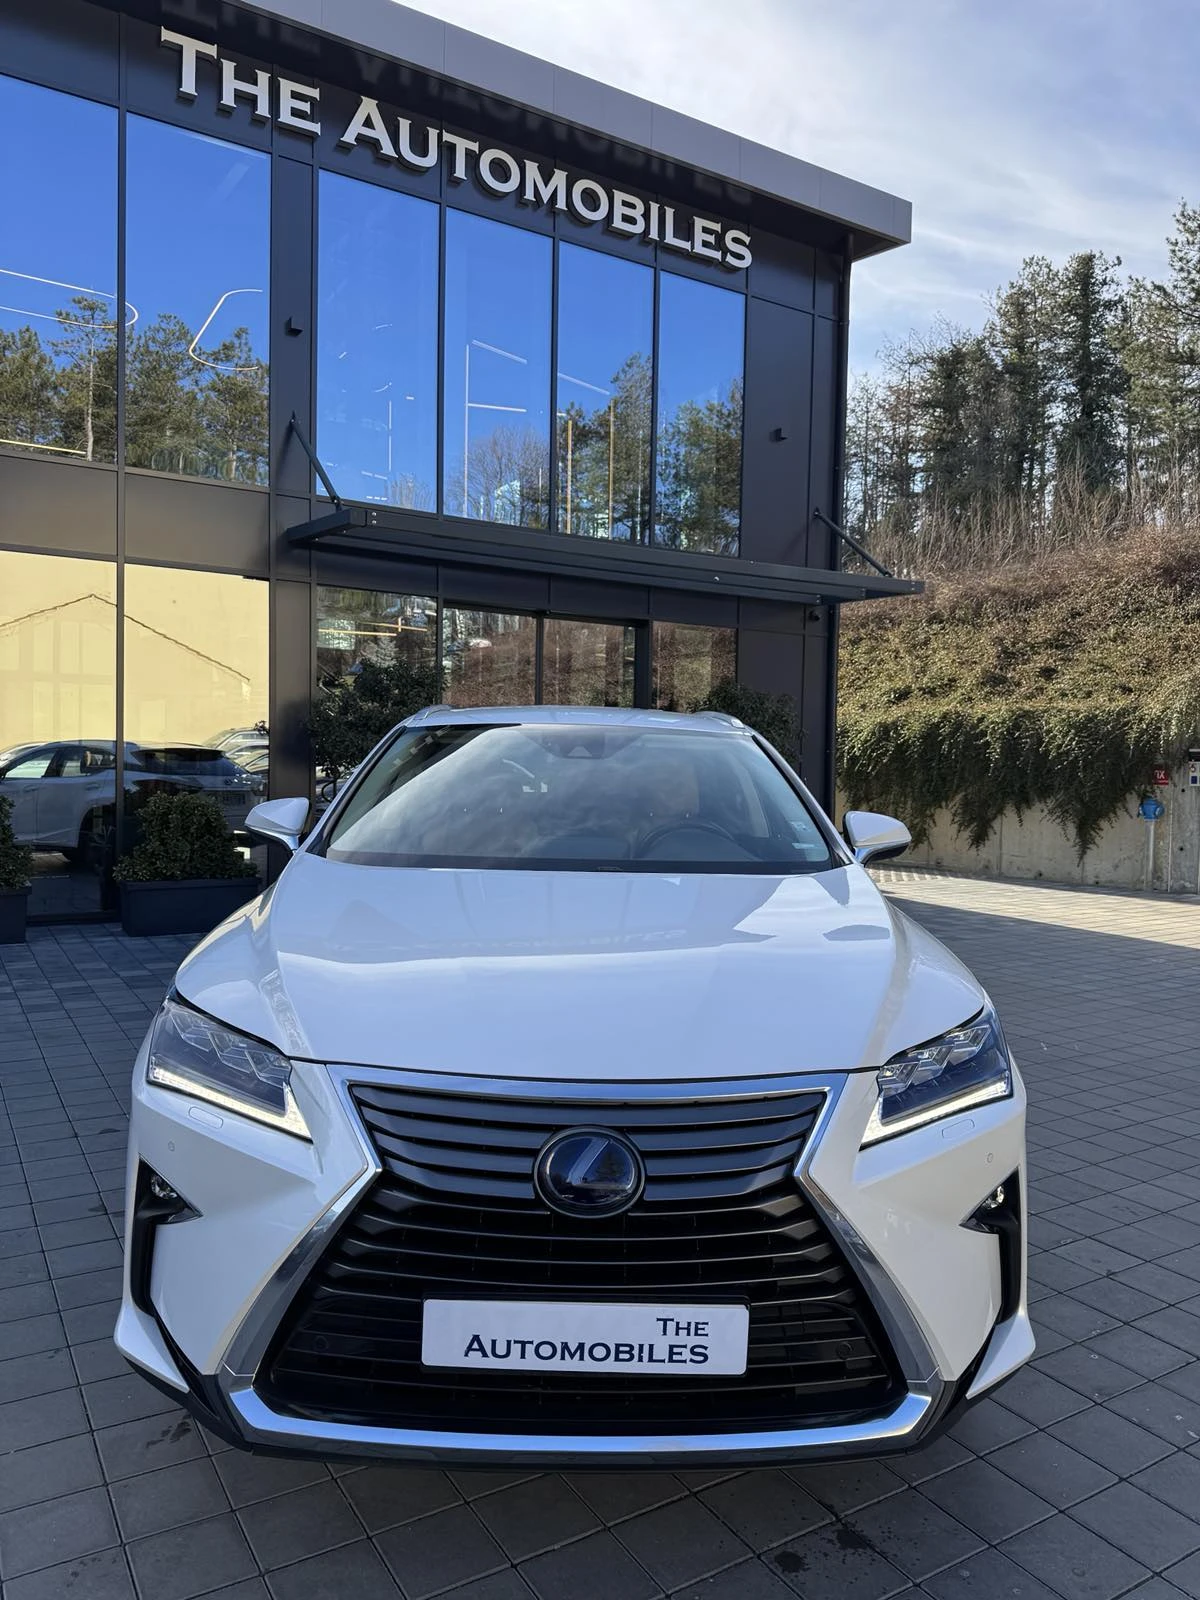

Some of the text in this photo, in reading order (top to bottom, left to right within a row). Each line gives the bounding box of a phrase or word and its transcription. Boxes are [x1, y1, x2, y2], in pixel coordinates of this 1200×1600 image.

[161, 26, 752, 269] THE AUTOMOBILES
[656, 1317, 709, 1337] THE
[464, 1334, 709, 1364] AUTOMOBILES
